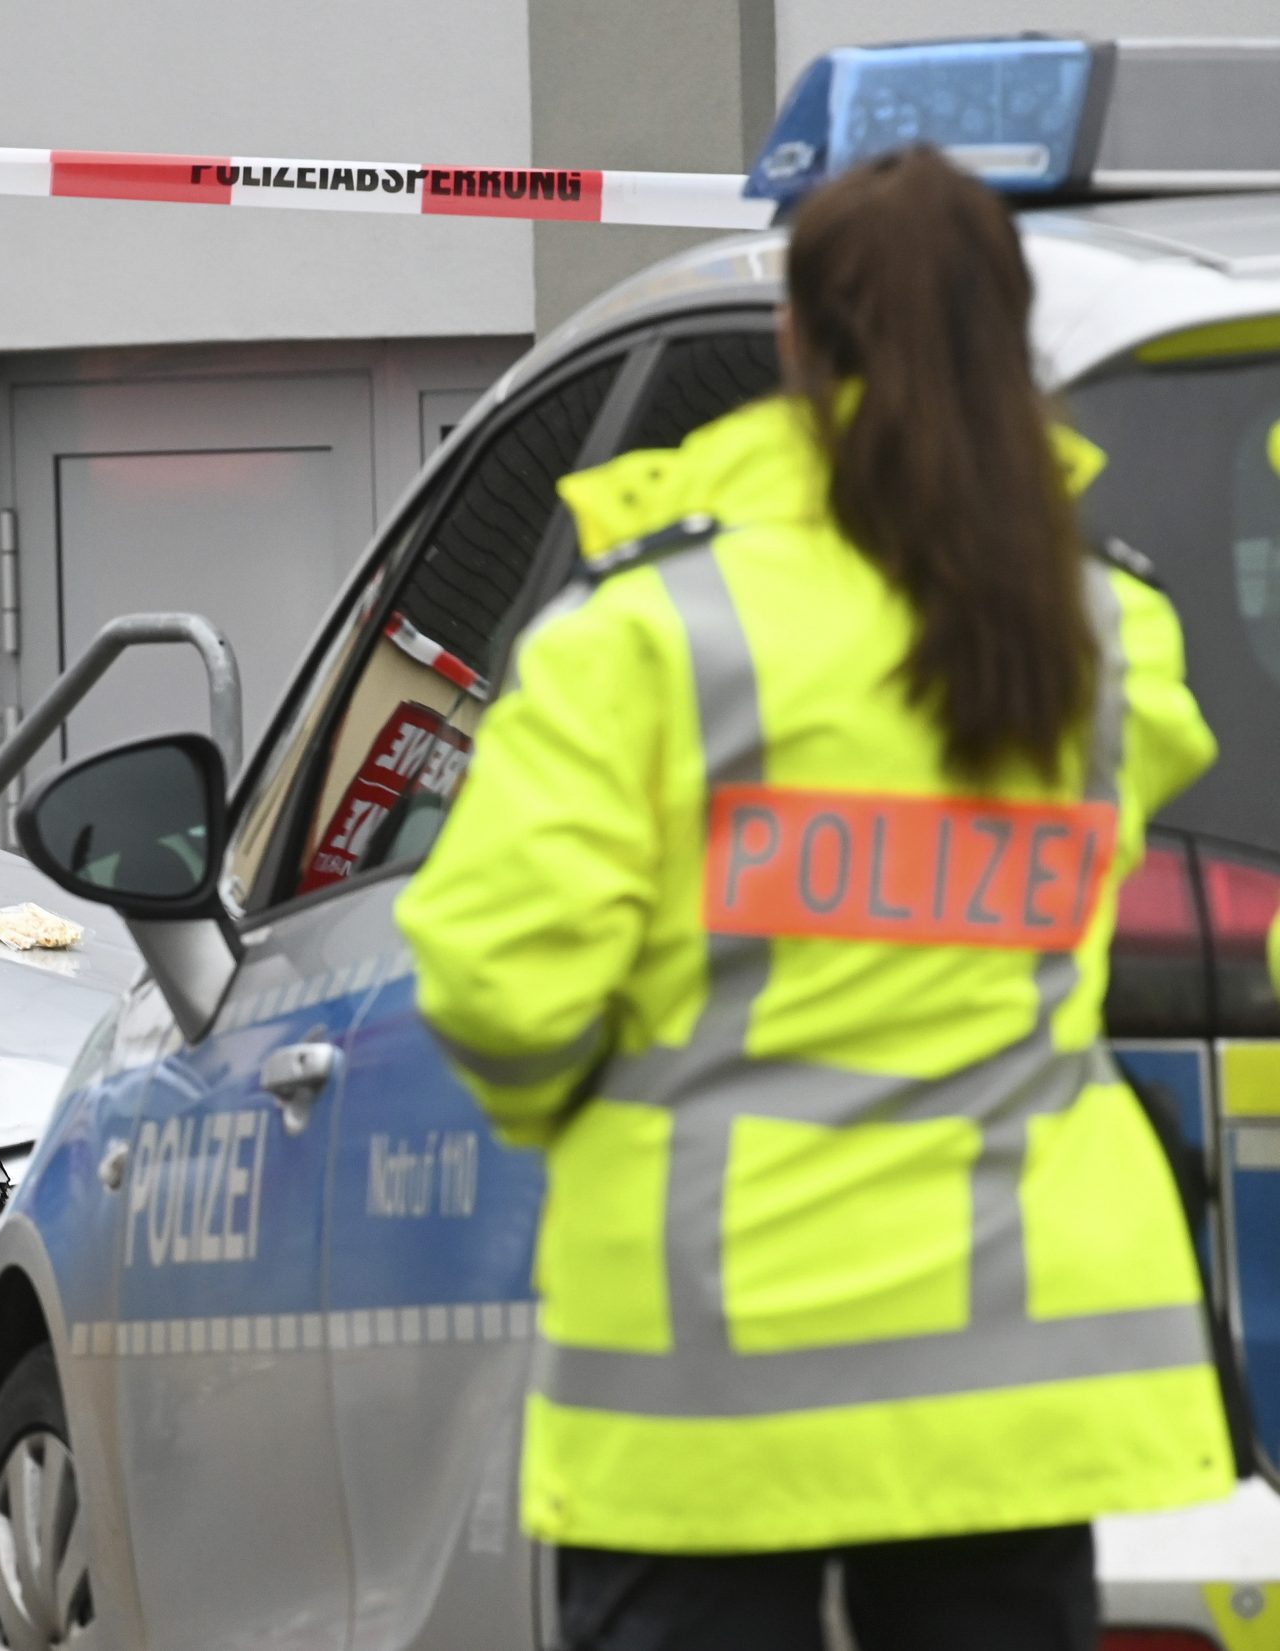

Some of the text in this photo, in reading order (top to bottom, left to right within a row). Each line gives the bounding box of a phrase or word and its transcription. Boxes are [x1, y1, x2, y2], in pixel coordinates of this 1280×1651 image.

[725, 805, 1097, 927] POLIZEI
[125, 1110, 269, 1268] POLIZEI
[366, 1130, 478, 1218] Notruf 110
